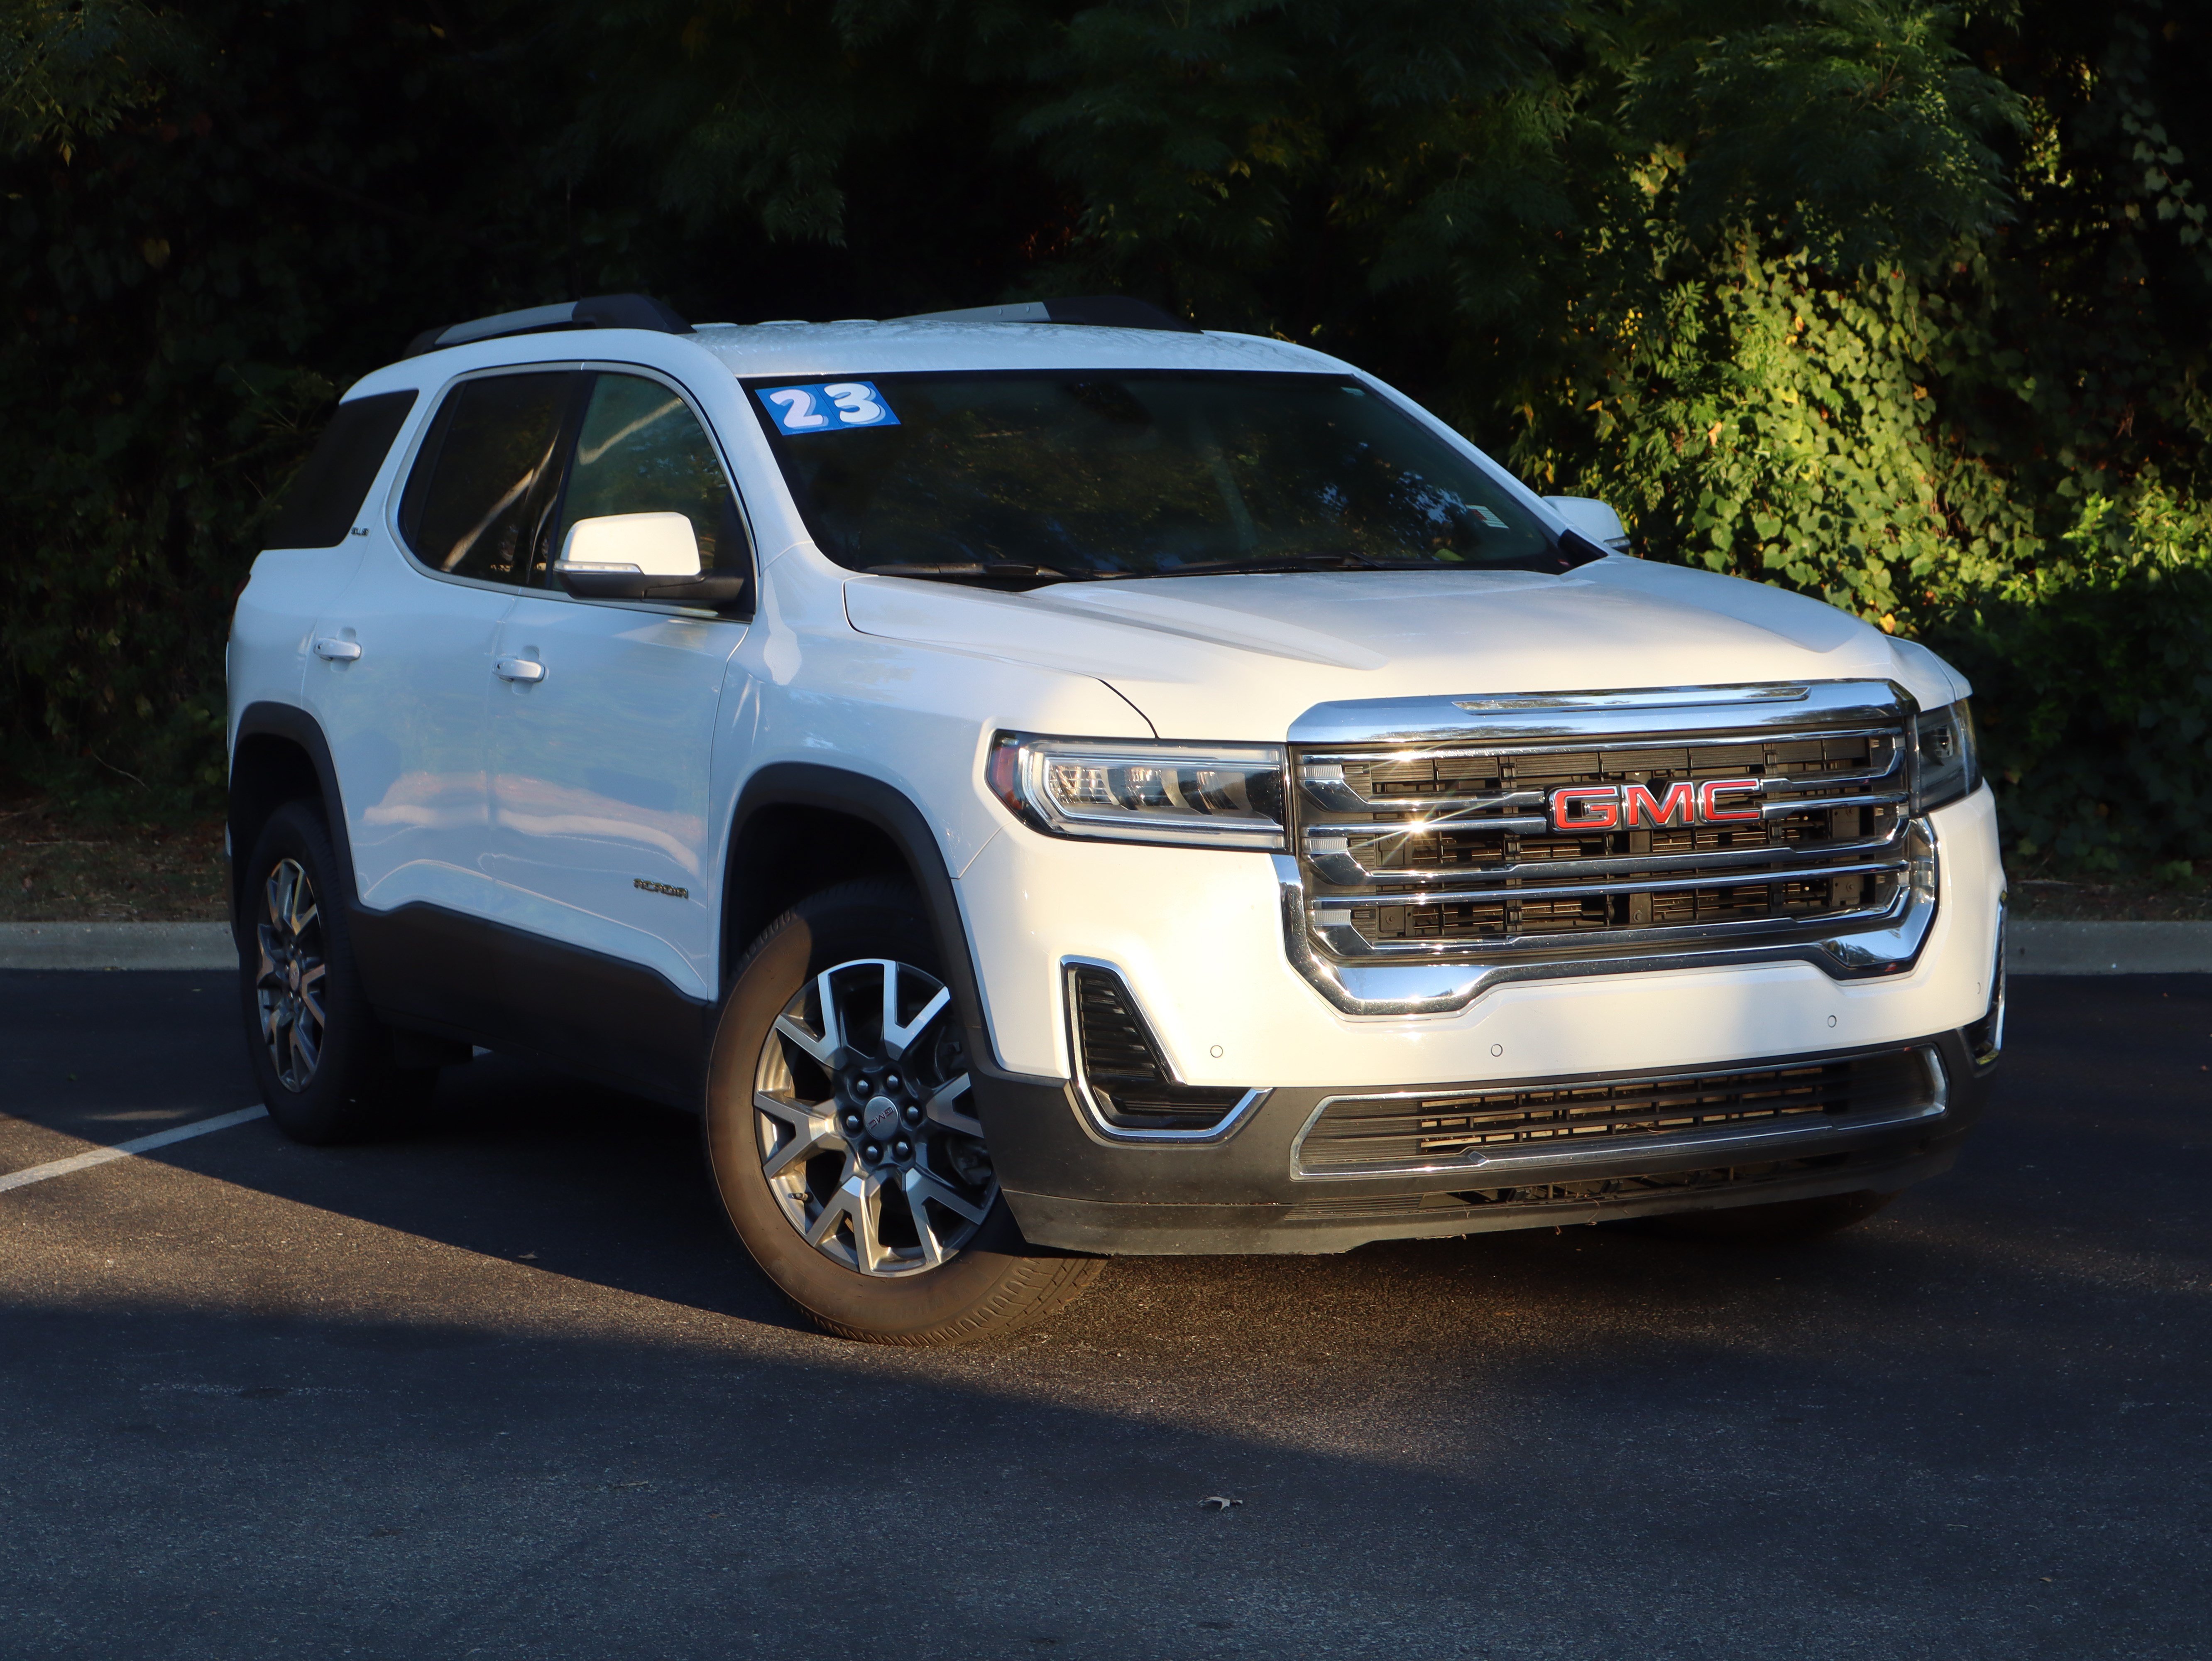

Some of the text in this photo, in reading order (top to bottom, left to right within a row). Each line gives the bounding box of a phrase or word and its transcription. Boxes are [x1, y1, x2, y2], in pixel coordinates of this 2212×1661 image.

[769, 382, 884, 429] 23
[1549, 777, 1761, 832] GMC
[633, 878, 689, 899] ACADIA
[868, 1106, 894, 1129] GMC
